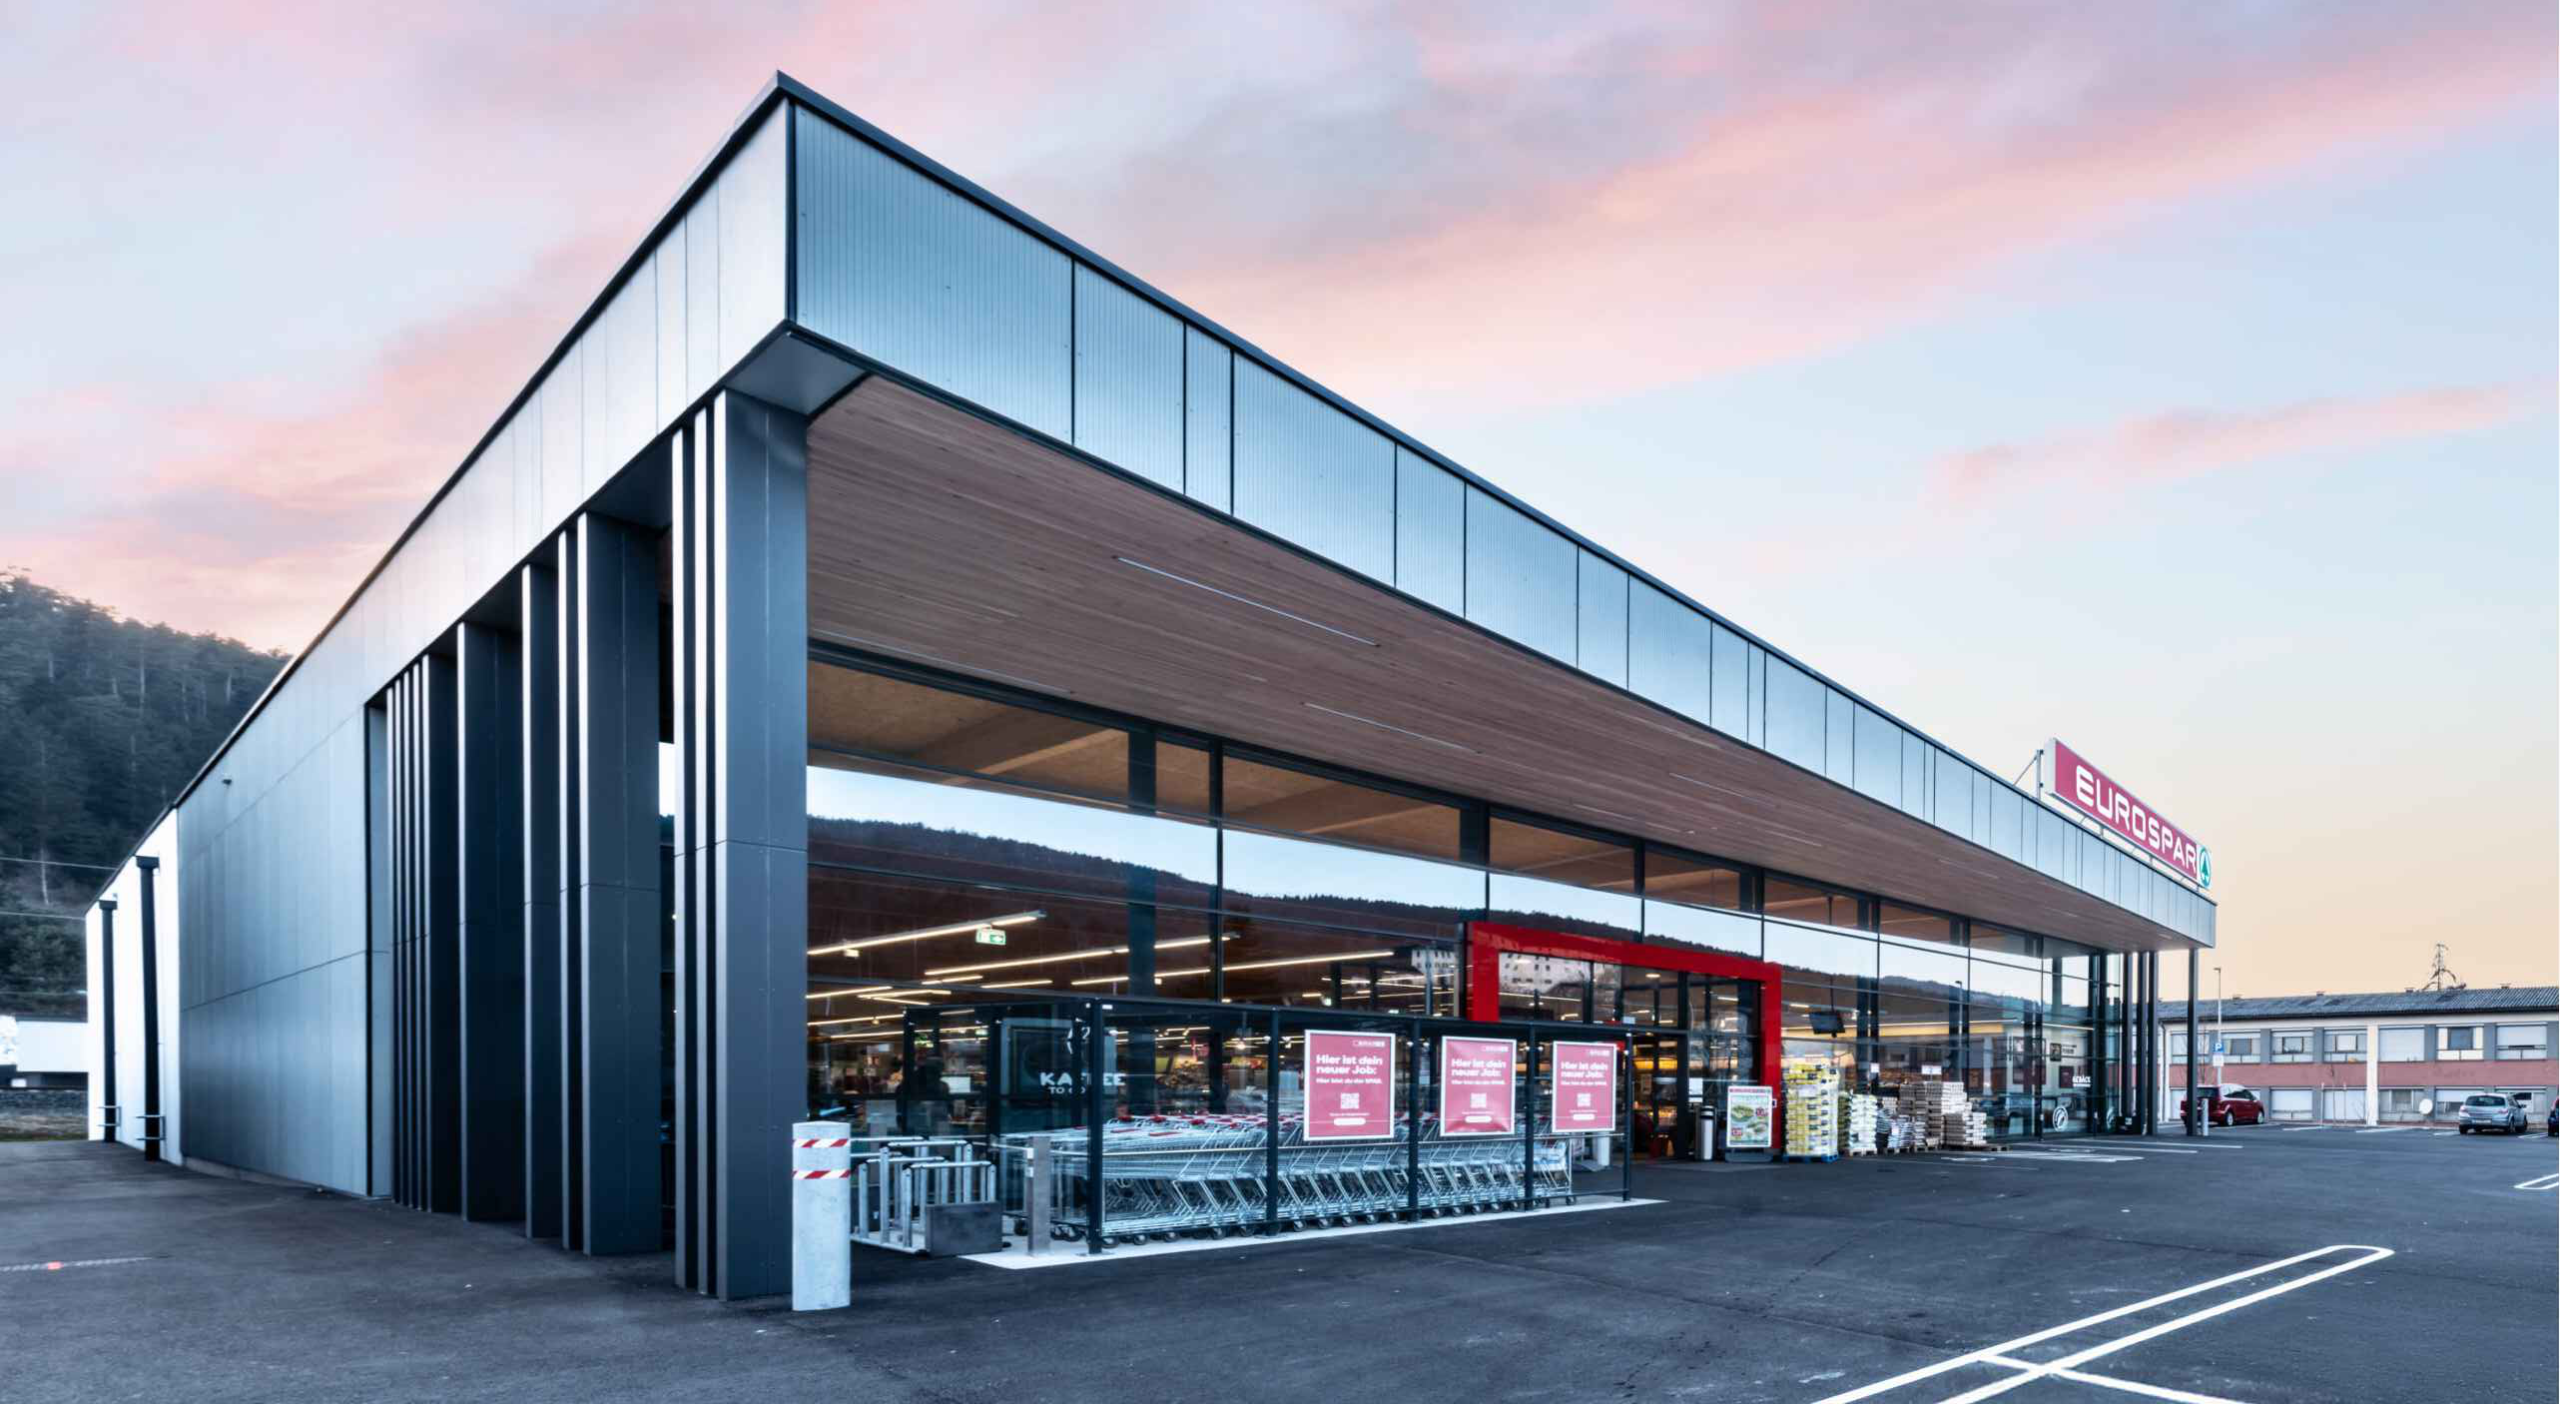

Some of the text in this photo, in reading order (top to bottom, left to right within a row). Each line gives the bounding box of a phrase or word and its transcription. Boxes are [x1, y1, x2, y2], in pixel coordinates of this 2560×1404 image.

[2076, 764, 2197, 874] EUROSPAR
[1315, 1053, 1383, 1066] Hier ist dein
[1451, 1058, 1507, 1069] Hier ist dein
[1315, 1064, 1377, 1075] neuer Job:
[1560, 1061, 1578, 1070] Hier
[1590, 1062, 1608, 1071] dein
[1451, 1069, 1480, 1077] neuer
[1560, 1071, 1584, 1079] neuer
[1049, 1086, 1066, 1094] TO
